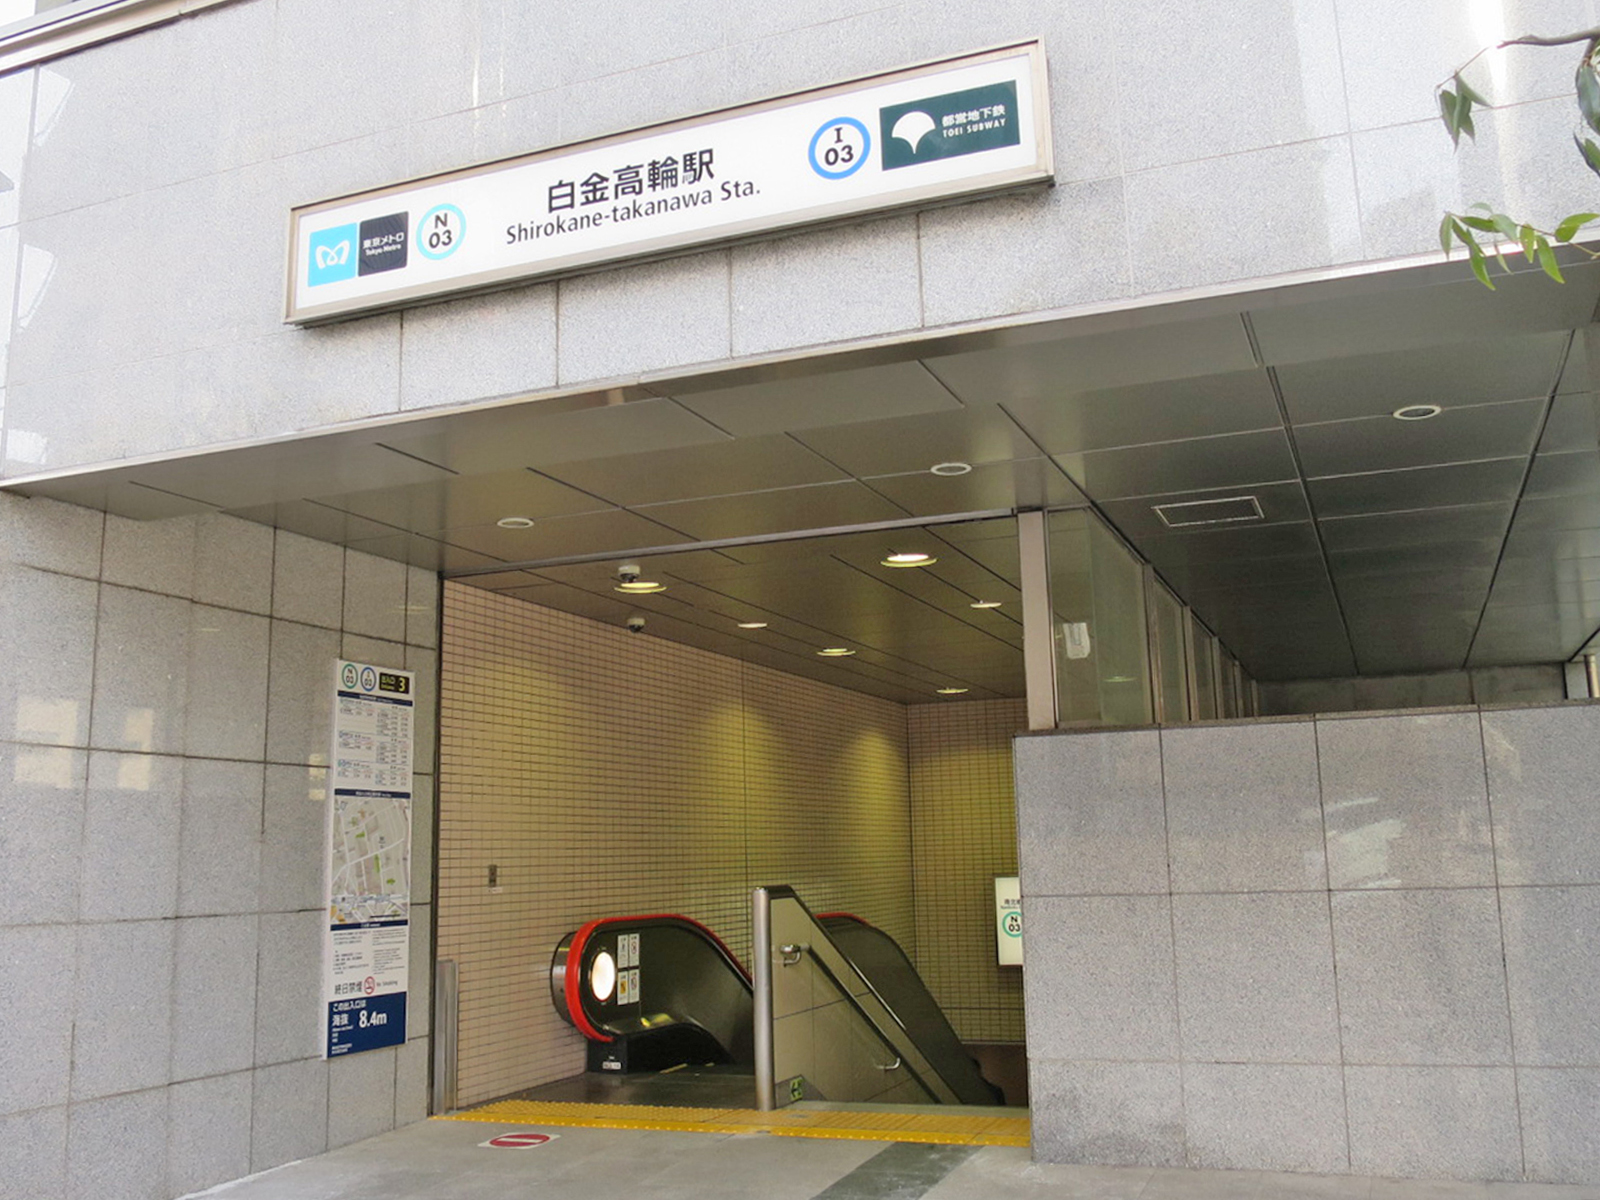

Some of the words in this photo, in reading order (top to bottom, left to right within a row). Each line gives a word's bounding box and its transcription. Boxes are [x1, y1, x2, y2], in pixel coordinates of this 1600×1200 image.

[833, 127, 843, 144] I
[942, 129, 963, 138] TOEI
[966, 118, 1006, 135] SUBWAY
[824, 144, 854, 166] 03
[547, 148, 715, 214] 白金高輪駅
[434, 212, 448, 229] N
[506, 189, 713, 245] Shirokane-takanawa
[720, 180, 761, 201] Sta.
[362, 231, 405, 250] 東京メトロ
[428, 229, 452, 249] 03
[365, 246, 384, 256] Tokyo
[384, 243, 402, 253] Metro
[398, 677, 406, 692] 3
[1008, 923, 1021, 932] 03
[359, 1010, 388, 1028] 8.4m
